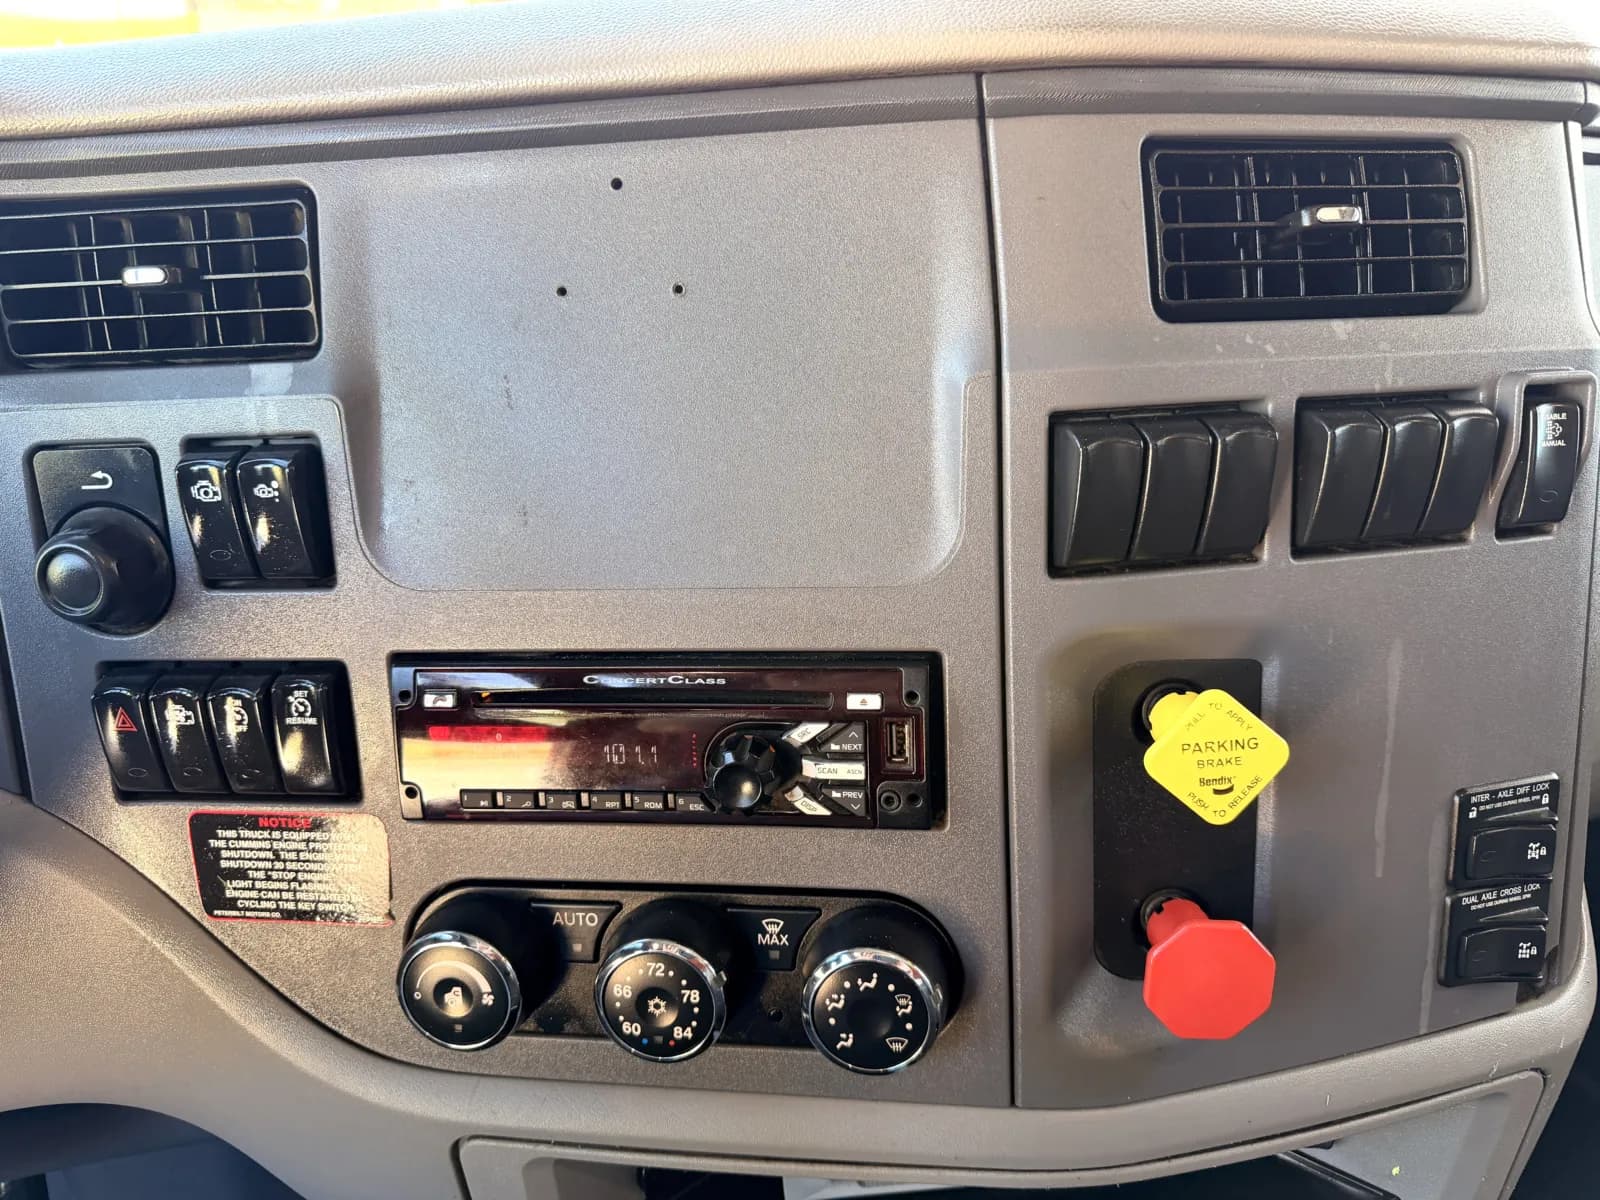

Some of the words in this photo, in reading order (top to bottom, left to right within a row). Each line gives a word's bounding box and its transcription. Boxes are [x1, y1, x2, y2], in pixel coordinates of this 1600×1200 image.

[293, 690, 309, 698] SET
[285, 717, 319, 725] RESUME
[1185, 712, 1206, 731] PULL
[1208, 702, 1223, 711] TO
[1226, 709, 1253, 731] APPLY
[841, 743, 863, 751] NEXT
[1181, 737, 1260, 755] PARKING
[1197, 756, 1244, 769] BRAKE
[817, 767, 838, 775] SCAN
[1199, 776, 1233, 787] Bendix
[842, 791, 863, 799] PREV
[1187, 791, 1210, 811] PUSH
[1212, 809, 1227, 818] TO
[1228, 775, 1264, 810] RELEASE
[1470, 792, 1490, 804] INTER
[1497, 788, 1515, 800] AXLE
[1516, 785, 1531, 795] DIFF
[1532, 782, 1550, 792] LOCK
[689, 803, 705, 811] ESC
[258, 817, 312, 829] NOTICE
[216, 829, 238, 838] THIS
[238, 830, 270, 839] TRUCK
[271, 830, 282, 839] IS
[282, 831, 329, 840] EQUIPPED
[208, 839, 228, 847] THE
[228, 840, 272, 849] CUMMINS
[272, 841, 308, 850] ENGINE
[279, 851, 298, 860] THE
[220, 859, 272, 869] SHUTDOWN
[247, 870, 266, 879] THE
[226, 879, 253, 888] LIGHT
[254, 880, 289, 889] BEGINS
[261, 890, 281, 899] CAN
[281, 891, 296, 900] BE
[1461, 895, 1479, 905] DUAL
[1481, 890, 1498, 901] AXLE
[1500, 886, 1522, 897] CROSS
[1523, 883, 1541, 892] LOCK
[237, 899, 277, 909] CYCLING
[278, 901, 297, 909] THE
[297, 902, 316, 910] KEY
[552, 912, 599, 926] AUTO
[757, 933, 789, 946] MAX
[646, 962, 665, 977] 72
[613, 983, 633, 998] 66
[680, 989, 700, 1004] 78
[622, 1021, 642, 1036] 60
[673, 1026, 693, 1040] 84
